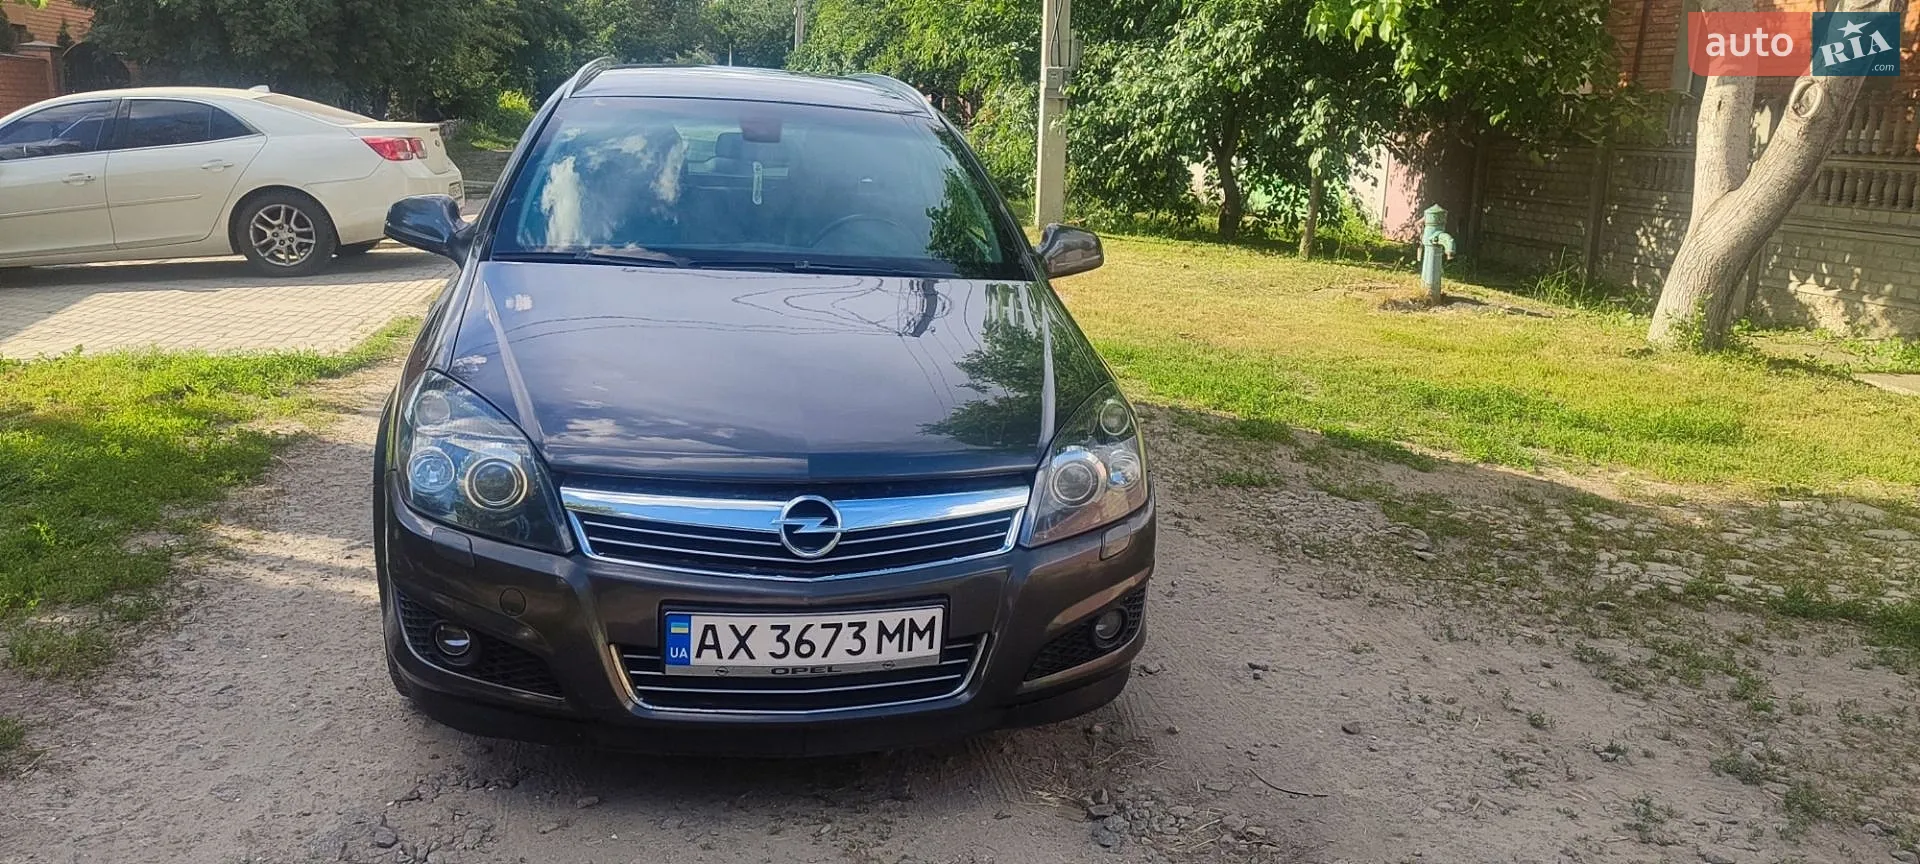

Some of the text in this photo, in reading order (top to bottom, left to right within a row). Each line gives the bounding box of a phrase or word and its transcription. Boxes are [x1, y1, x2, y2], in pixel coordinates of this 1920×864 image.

[695, 615, 936, 660] AX 3673 MM
[670, 648, 689, 659] UA
[771, 665, 842, 676] OPEL
